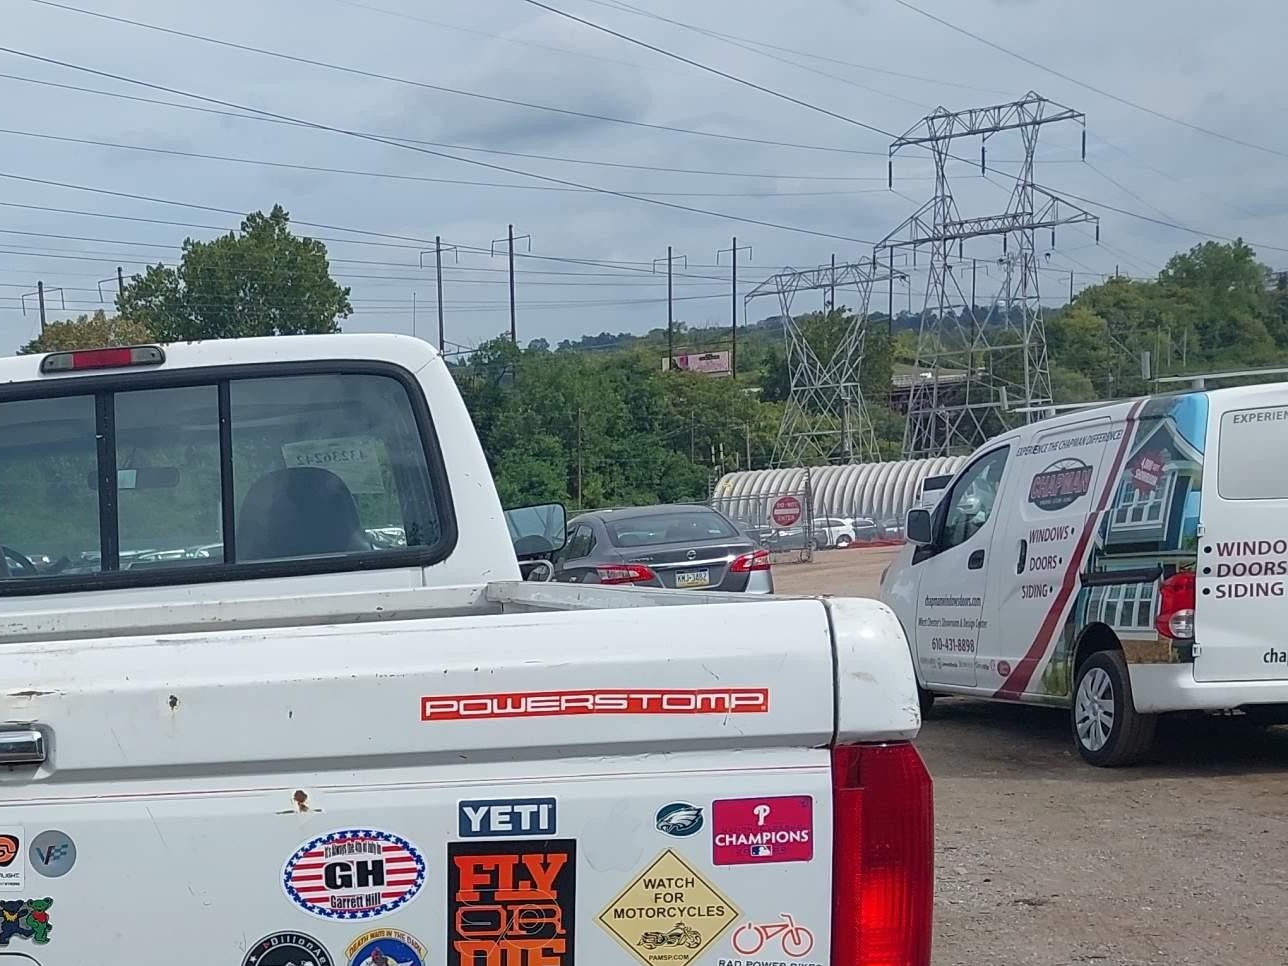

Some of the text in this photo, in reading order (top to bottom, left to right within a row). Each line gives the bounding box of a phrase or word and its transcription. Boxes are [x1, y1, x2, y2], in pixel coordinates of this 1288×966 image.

[1016, 443, 1048, 456] EXPERIENCE
[1048, 440, 1059, 451] THE
[1059, 437, 1086, 450] CHAPMAN
[1030, 468, 1092, 500] CHAPMAN
[1029, 525, 1069, 544] WINDOWS
[1030, 555, 1057, 571] DOORS
[1216, 561, 1288, 577] DOORS
[1021, 583, 1047, 599] SIDING
[1215, 582, 1284, 598] SIDING
[932, 638, 974, 653] 610-431-8898
[1263, 648, 1288, 664] cha
[425, 693, 764, 716] POWERSTOMP
[462, 804, 549, 832] YETI
[715, 830, 809, 846] CHAMPIONS
[324, 860, 385, 889] GH
[453, 853, 567, 901] FLY
[643, 878, 695, 889] WATCH
[331, 892, 381, 908] Garrett Hill
[654, 892, 684, 904] FOR
[456, 904, 566, 936] OR
[614, 906, 725, 919] MOTORCYCLES
[349, 935, 369, 957] DEATH
[394, 931, 406, 940] THE
